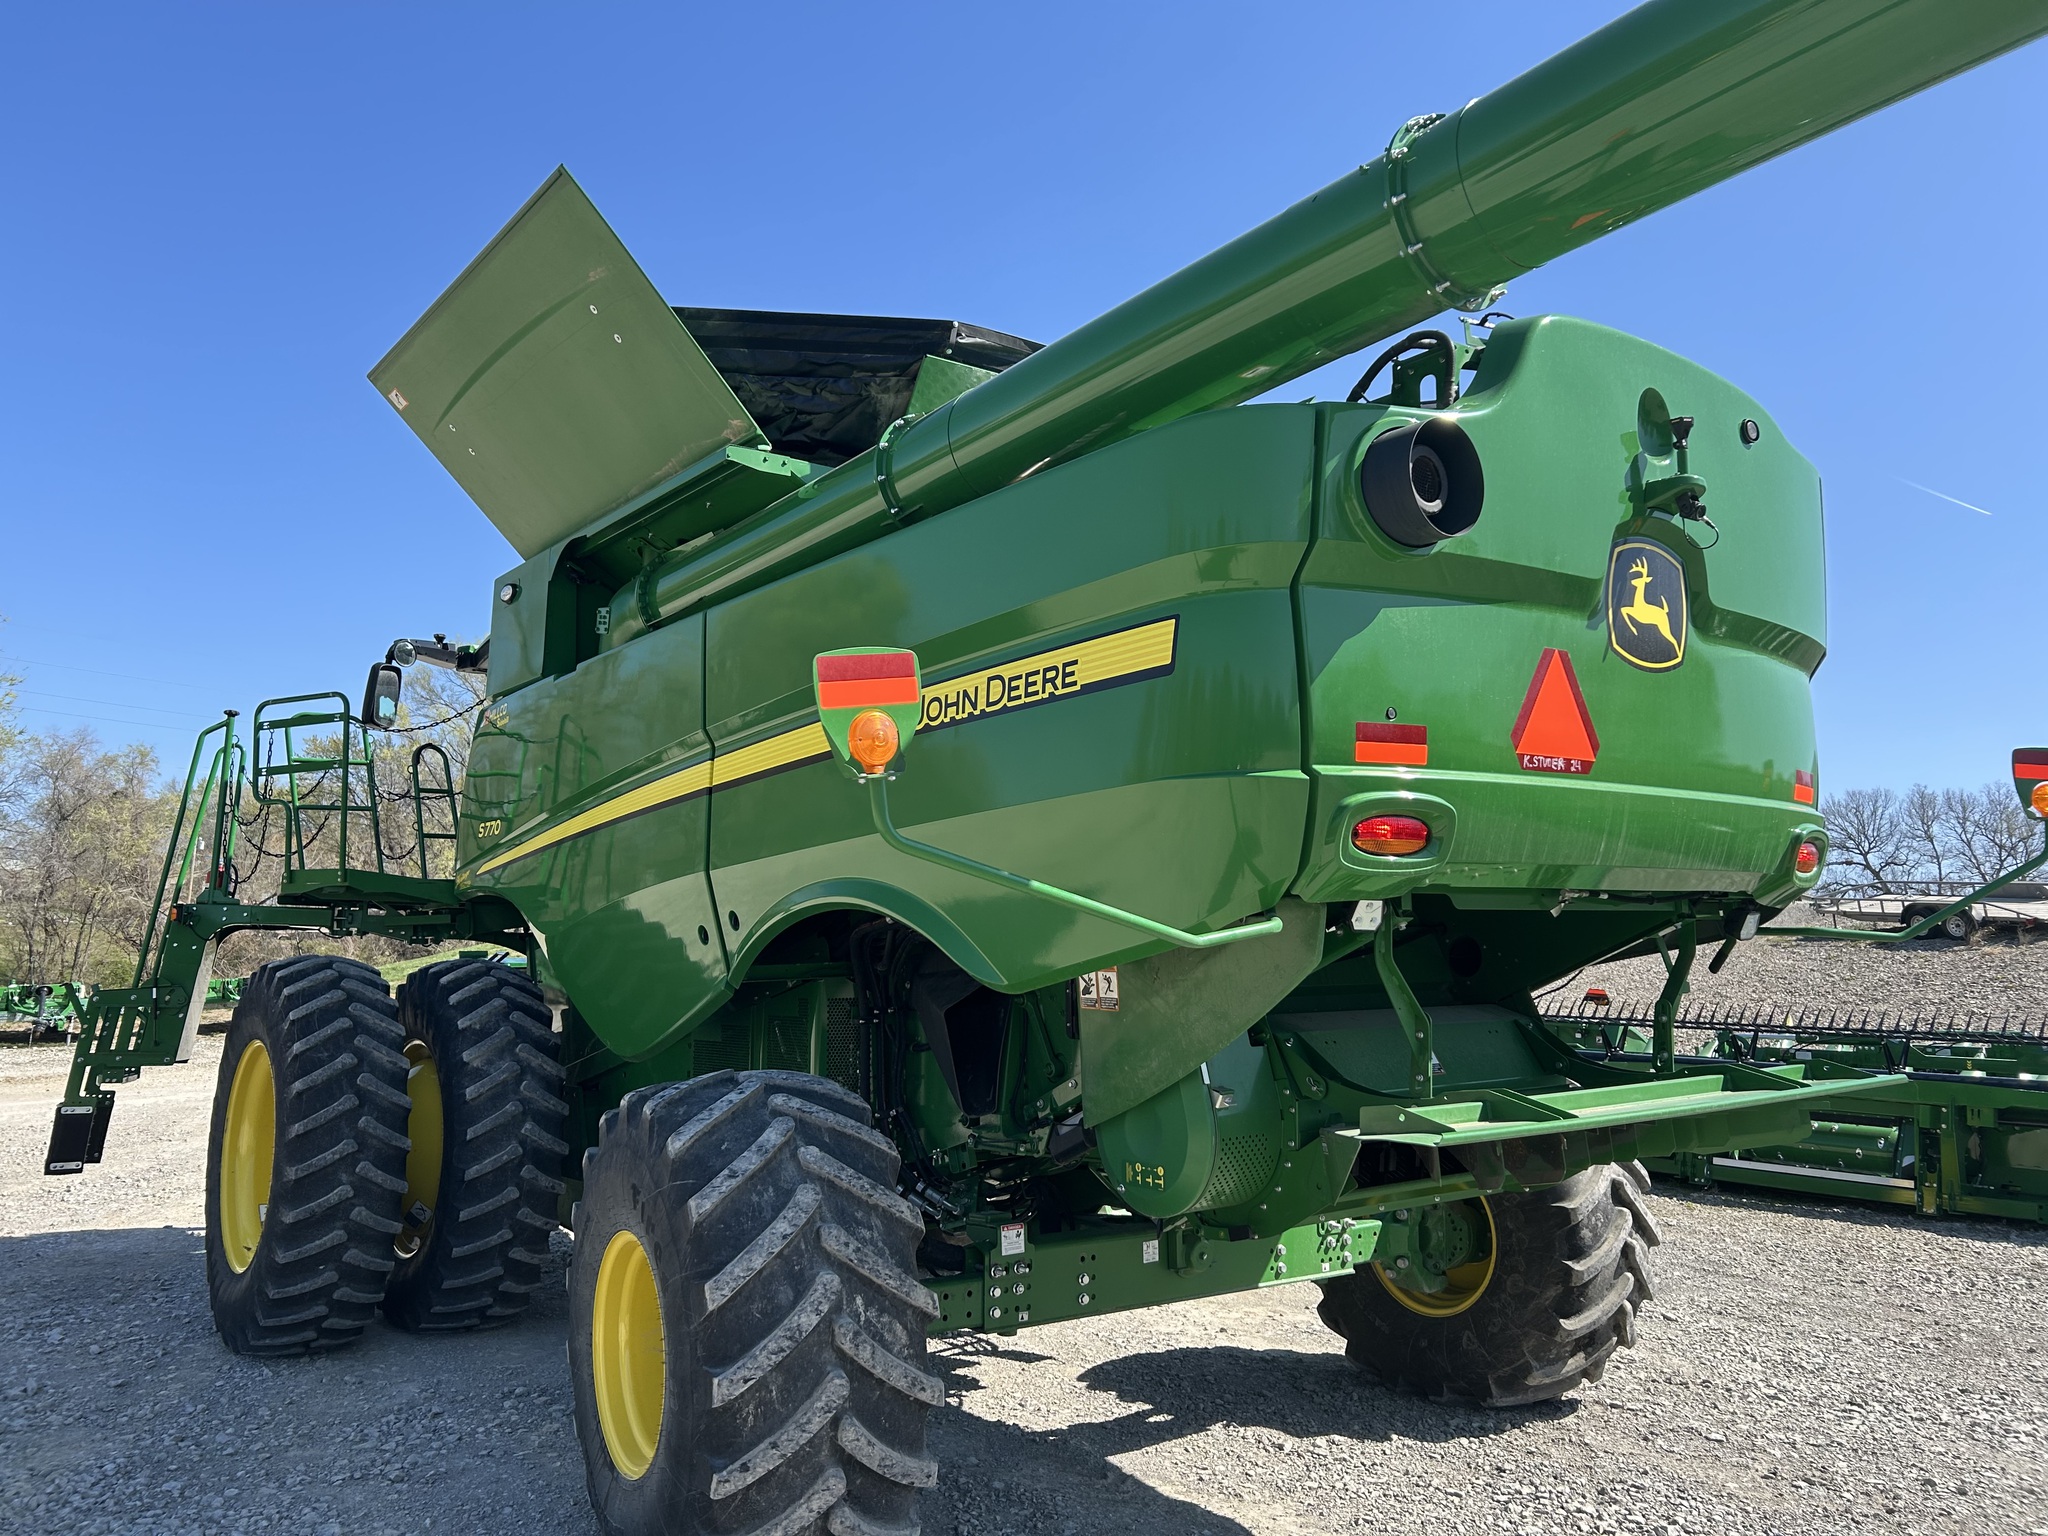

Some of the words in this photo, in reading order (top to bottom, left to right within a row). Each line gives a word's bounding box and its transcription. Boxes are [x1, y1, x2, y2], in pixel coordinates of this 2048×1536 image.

[918, 685, 979, 726] JOHN
[985, 658, 1079, 709] DEERE
[478, 819, 502, 838] S770
